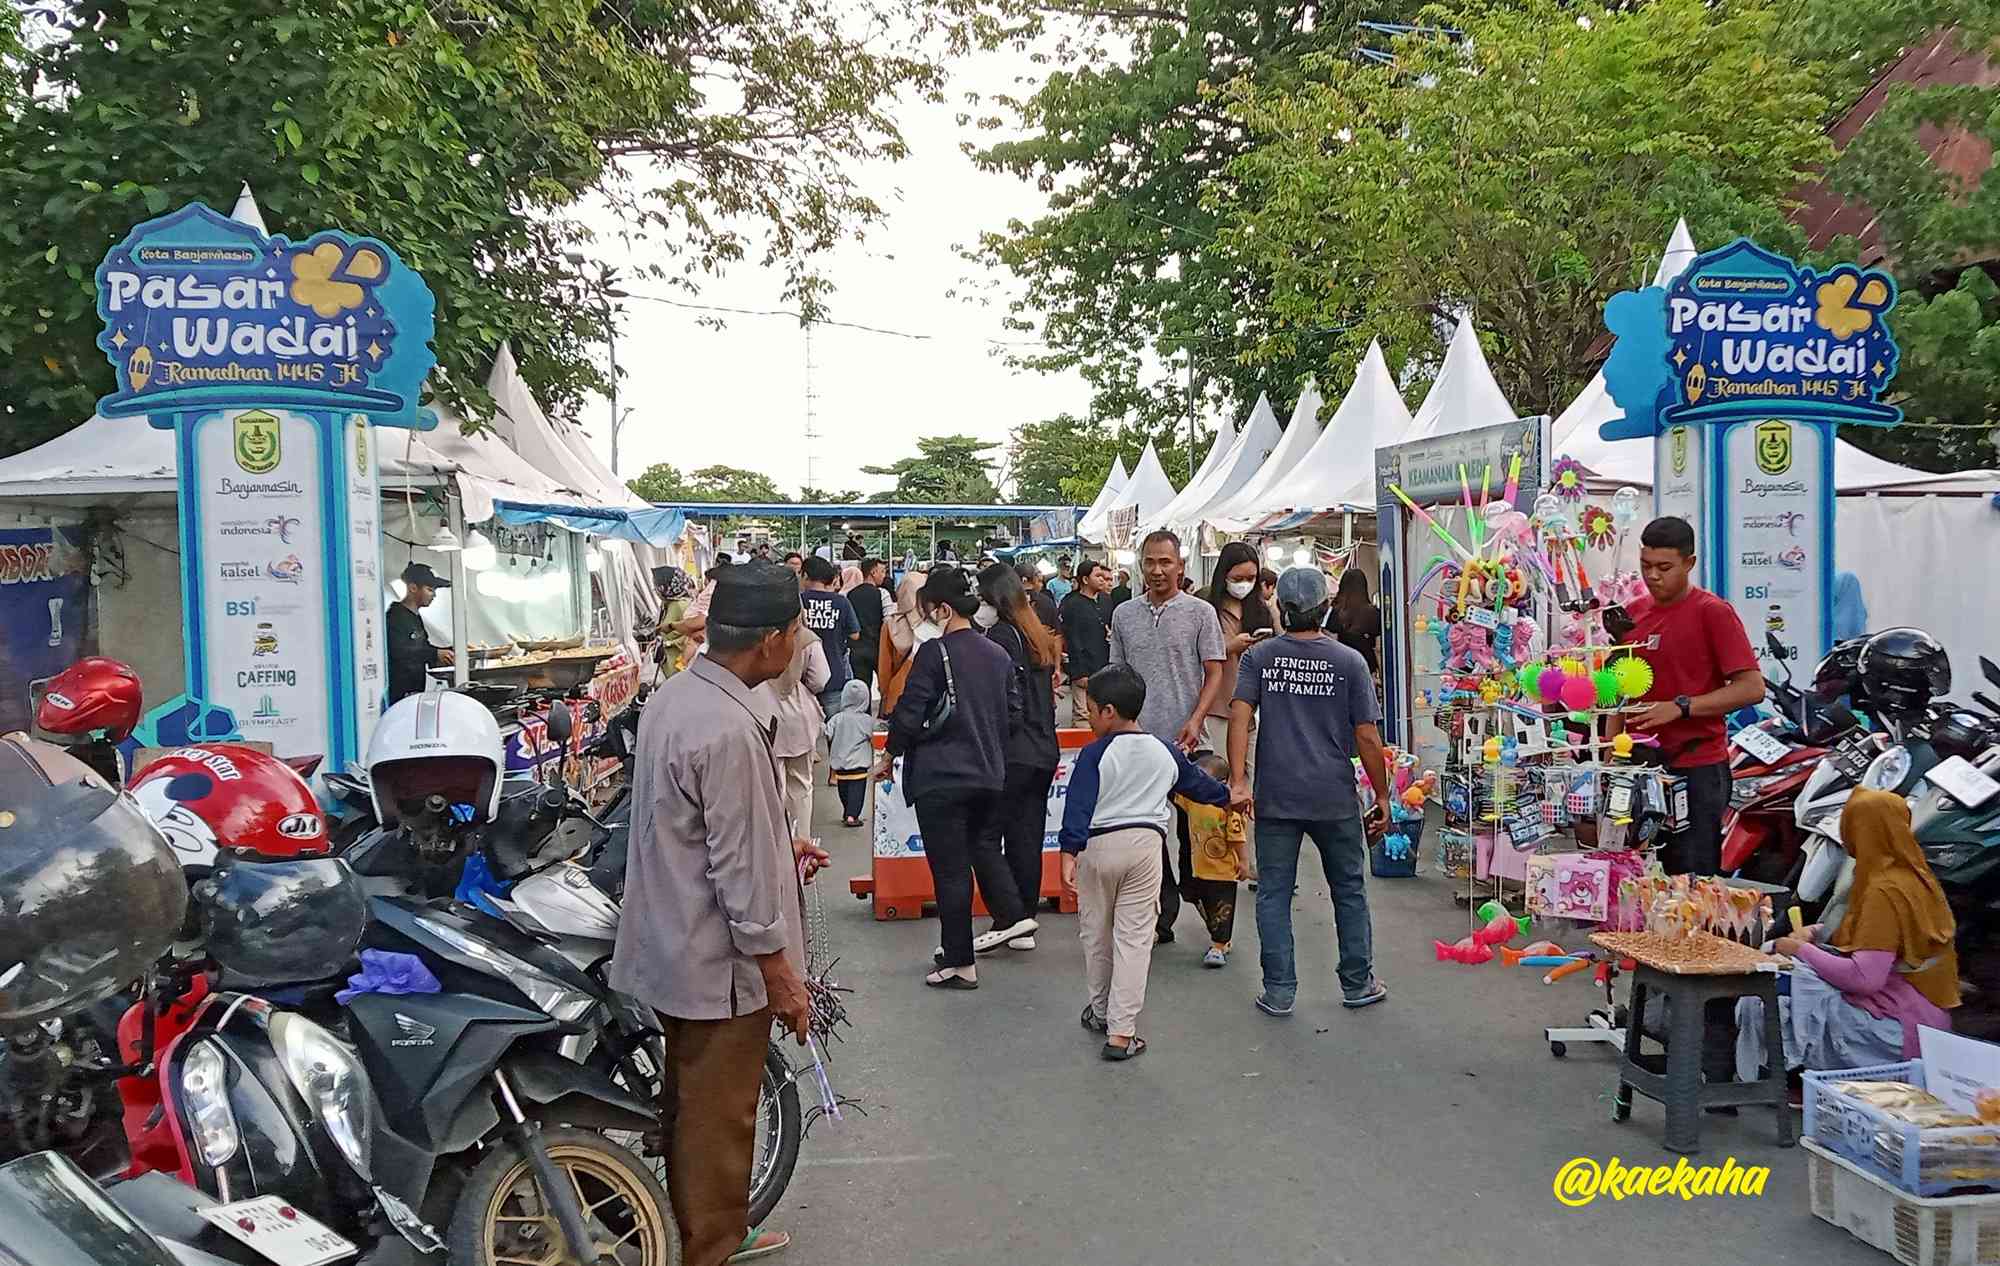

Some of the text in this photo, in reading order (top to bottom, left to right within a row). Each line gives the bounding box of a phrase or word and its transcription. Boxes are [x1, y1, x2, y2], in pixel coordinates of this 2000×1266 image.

[141, 248, 253, 264] Kota Banjarmasin
[106, 269, 286, 312] Pasar
[1670, 297, 1812, 334] Pasar
[172, 315, 360, 361] Wadai
[1721, 338, 1867, 378] Wadai
[155, 361, 274, 385] Ramadhan
[277, 362, 326, 382] 1445
[1706, 377, 1799, 399] Ramadhan
[1801, 378, 1839, 397] 1445
[220, 526, 272, 535] indonesia
[1742, 555, 1772, 566] kalsel
[219, 565, 260, 577] kalsel
[1745, 586, 1768, 599] BSI
[226, 601, 256, 616] BSI
[809, 600, 832, 610] THE
[802, 609, 840, 620] EACH
[807, 619, 835, 629] HAUS
[1262, 668, 1280, 679] MY
[1283, 669, 1334, 683] PASSION
[1268, 681, 1335, 696] MY FAMILY.
